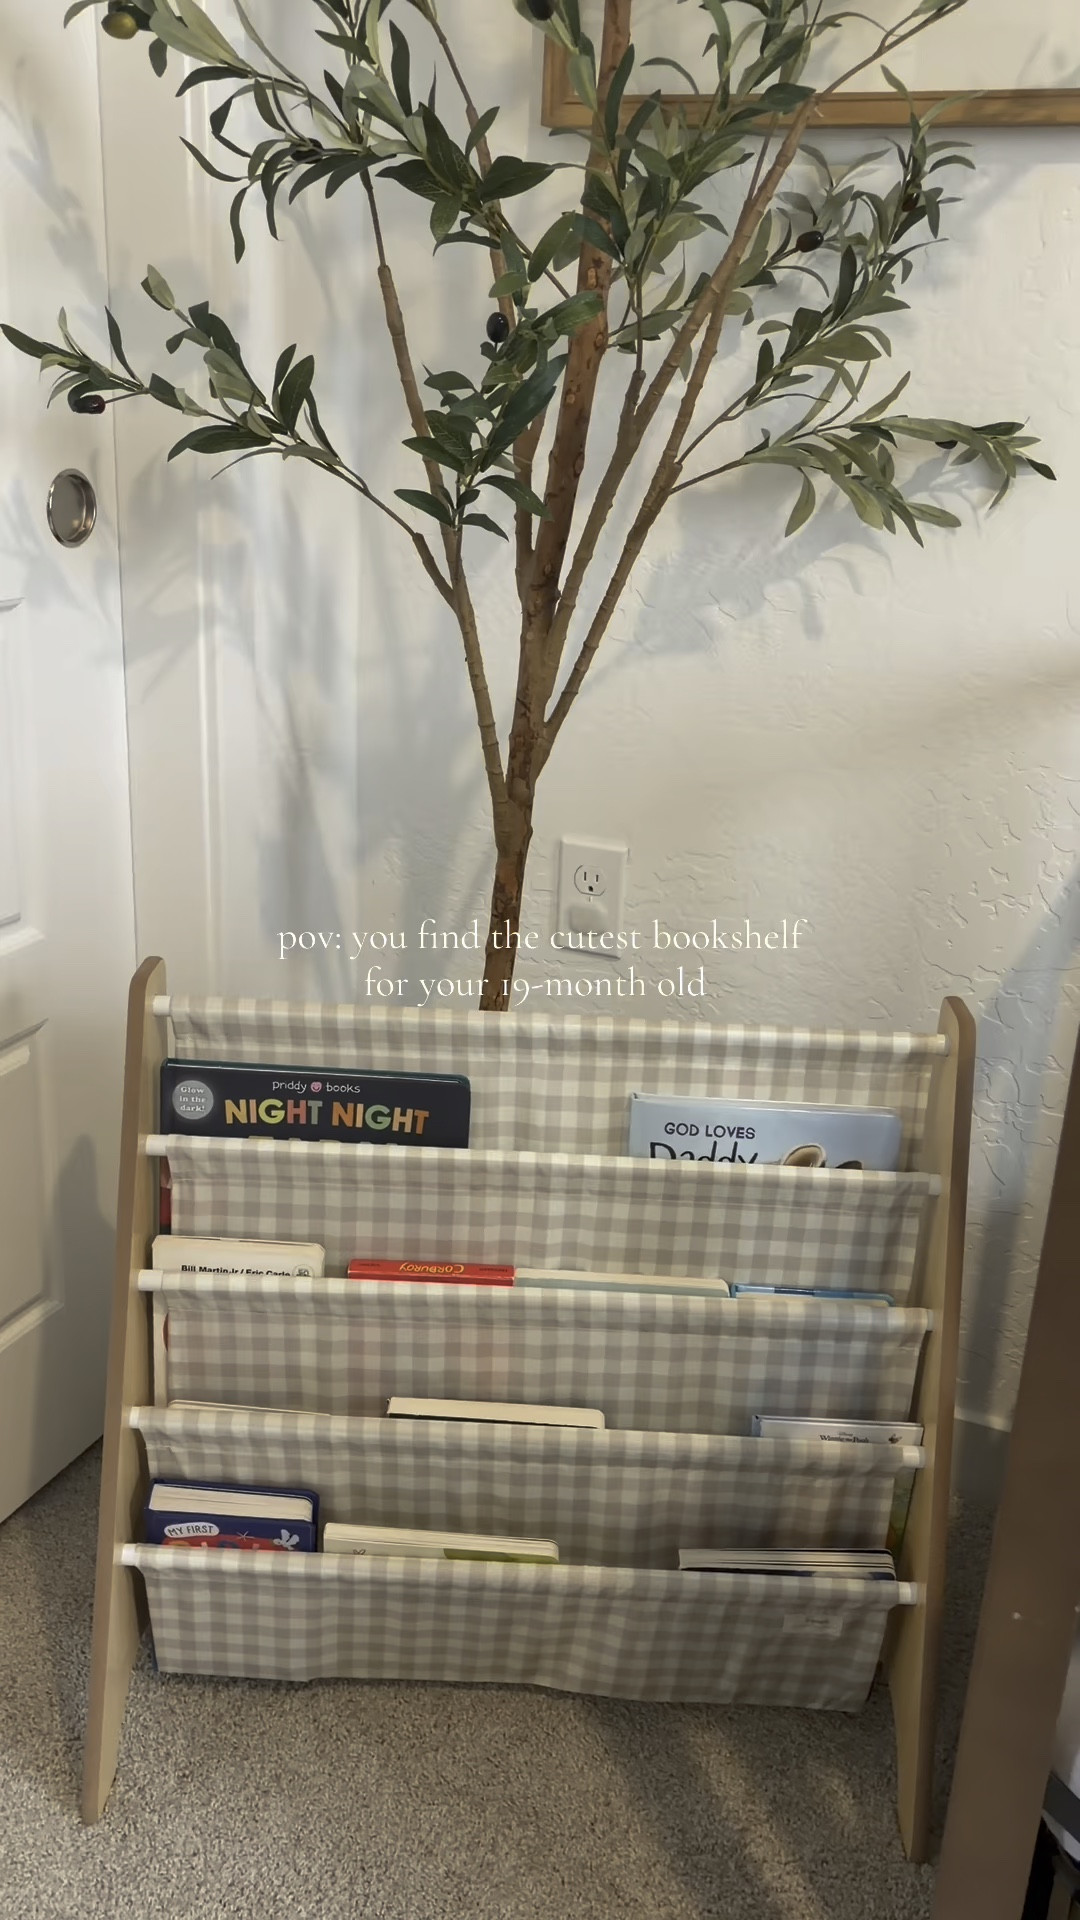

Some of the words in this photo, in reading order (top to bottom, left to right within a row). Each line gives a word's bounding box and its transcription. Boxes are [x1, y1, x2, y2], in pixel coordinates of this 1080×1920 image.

[180, 1086, 205, 1094] Glow
[272, 1081, 307, 1094] priddy
[326, 1082, 361, 1094] books
[180, 1104, 205, 1112] dark!
[224, 1098, 323, 1125] NIGHT
[331, 1101, 430, 1135] NIGHT
[664, 1122, 700, 1136] GOD
[705, 1124, 756, 1140] LOVES
[181, 1264, 196, 1273] Bill
[198, 1265, 229, 1274] Martin
[167, 1526, 183, 1536] MY
[186, 1525, 214, 1534] FIRST
